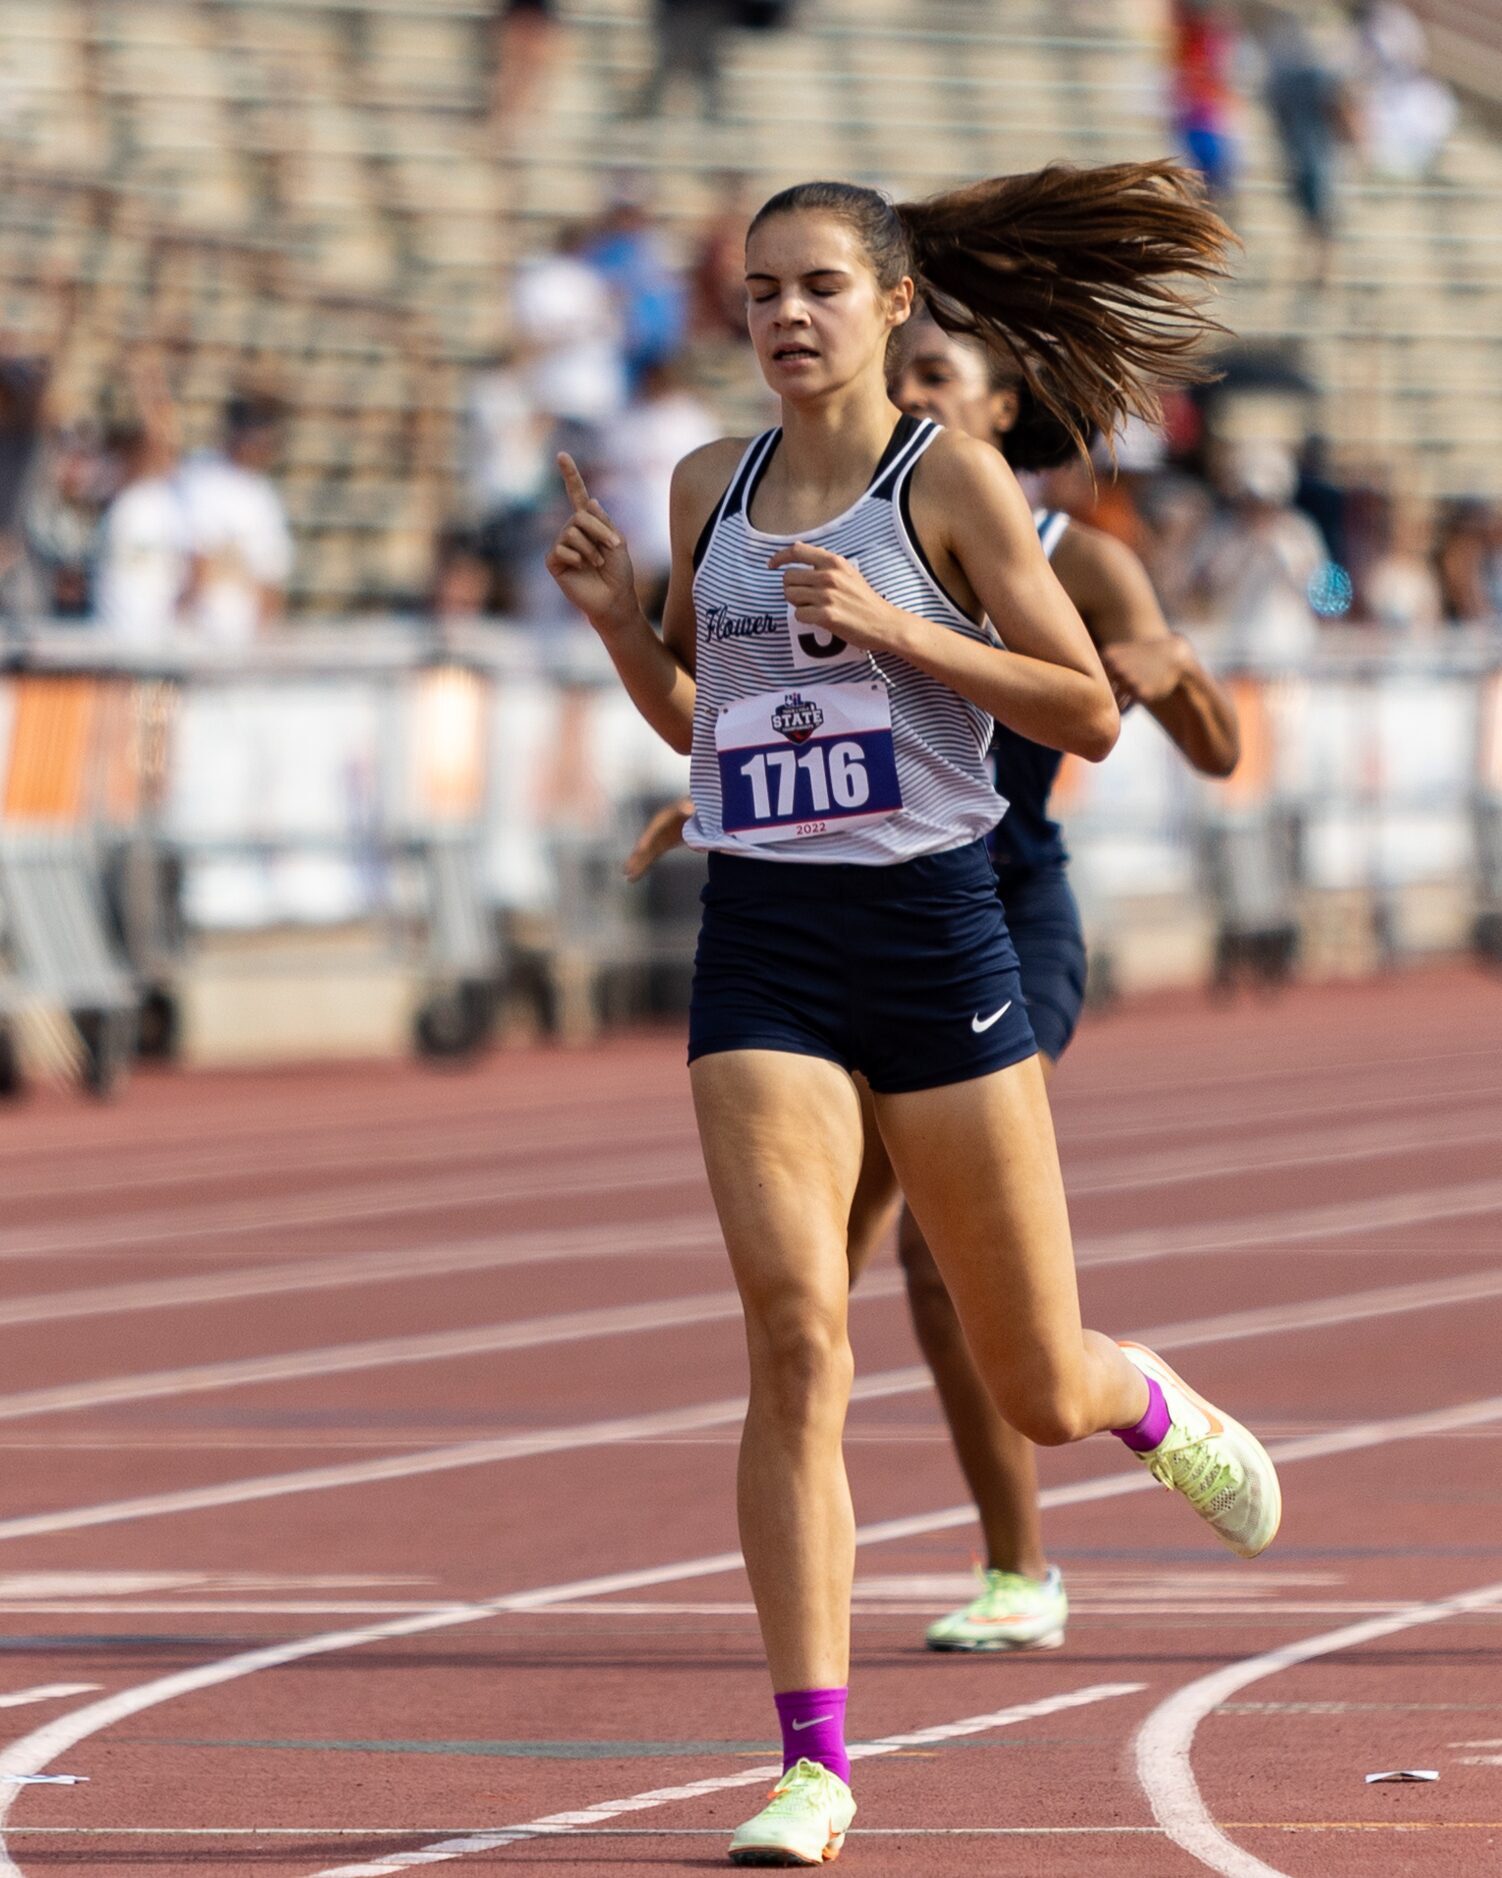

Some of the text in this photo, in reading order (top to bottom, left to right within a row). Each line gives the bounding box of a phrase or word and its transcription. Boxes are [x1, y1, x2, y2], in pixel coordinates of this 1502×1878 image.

[705, 604, 777, 643] Flower
[772, 709, 823, 729] STATE
[740, 741, 870, 819] 1716
[796, 822, 827, 835] 2022
